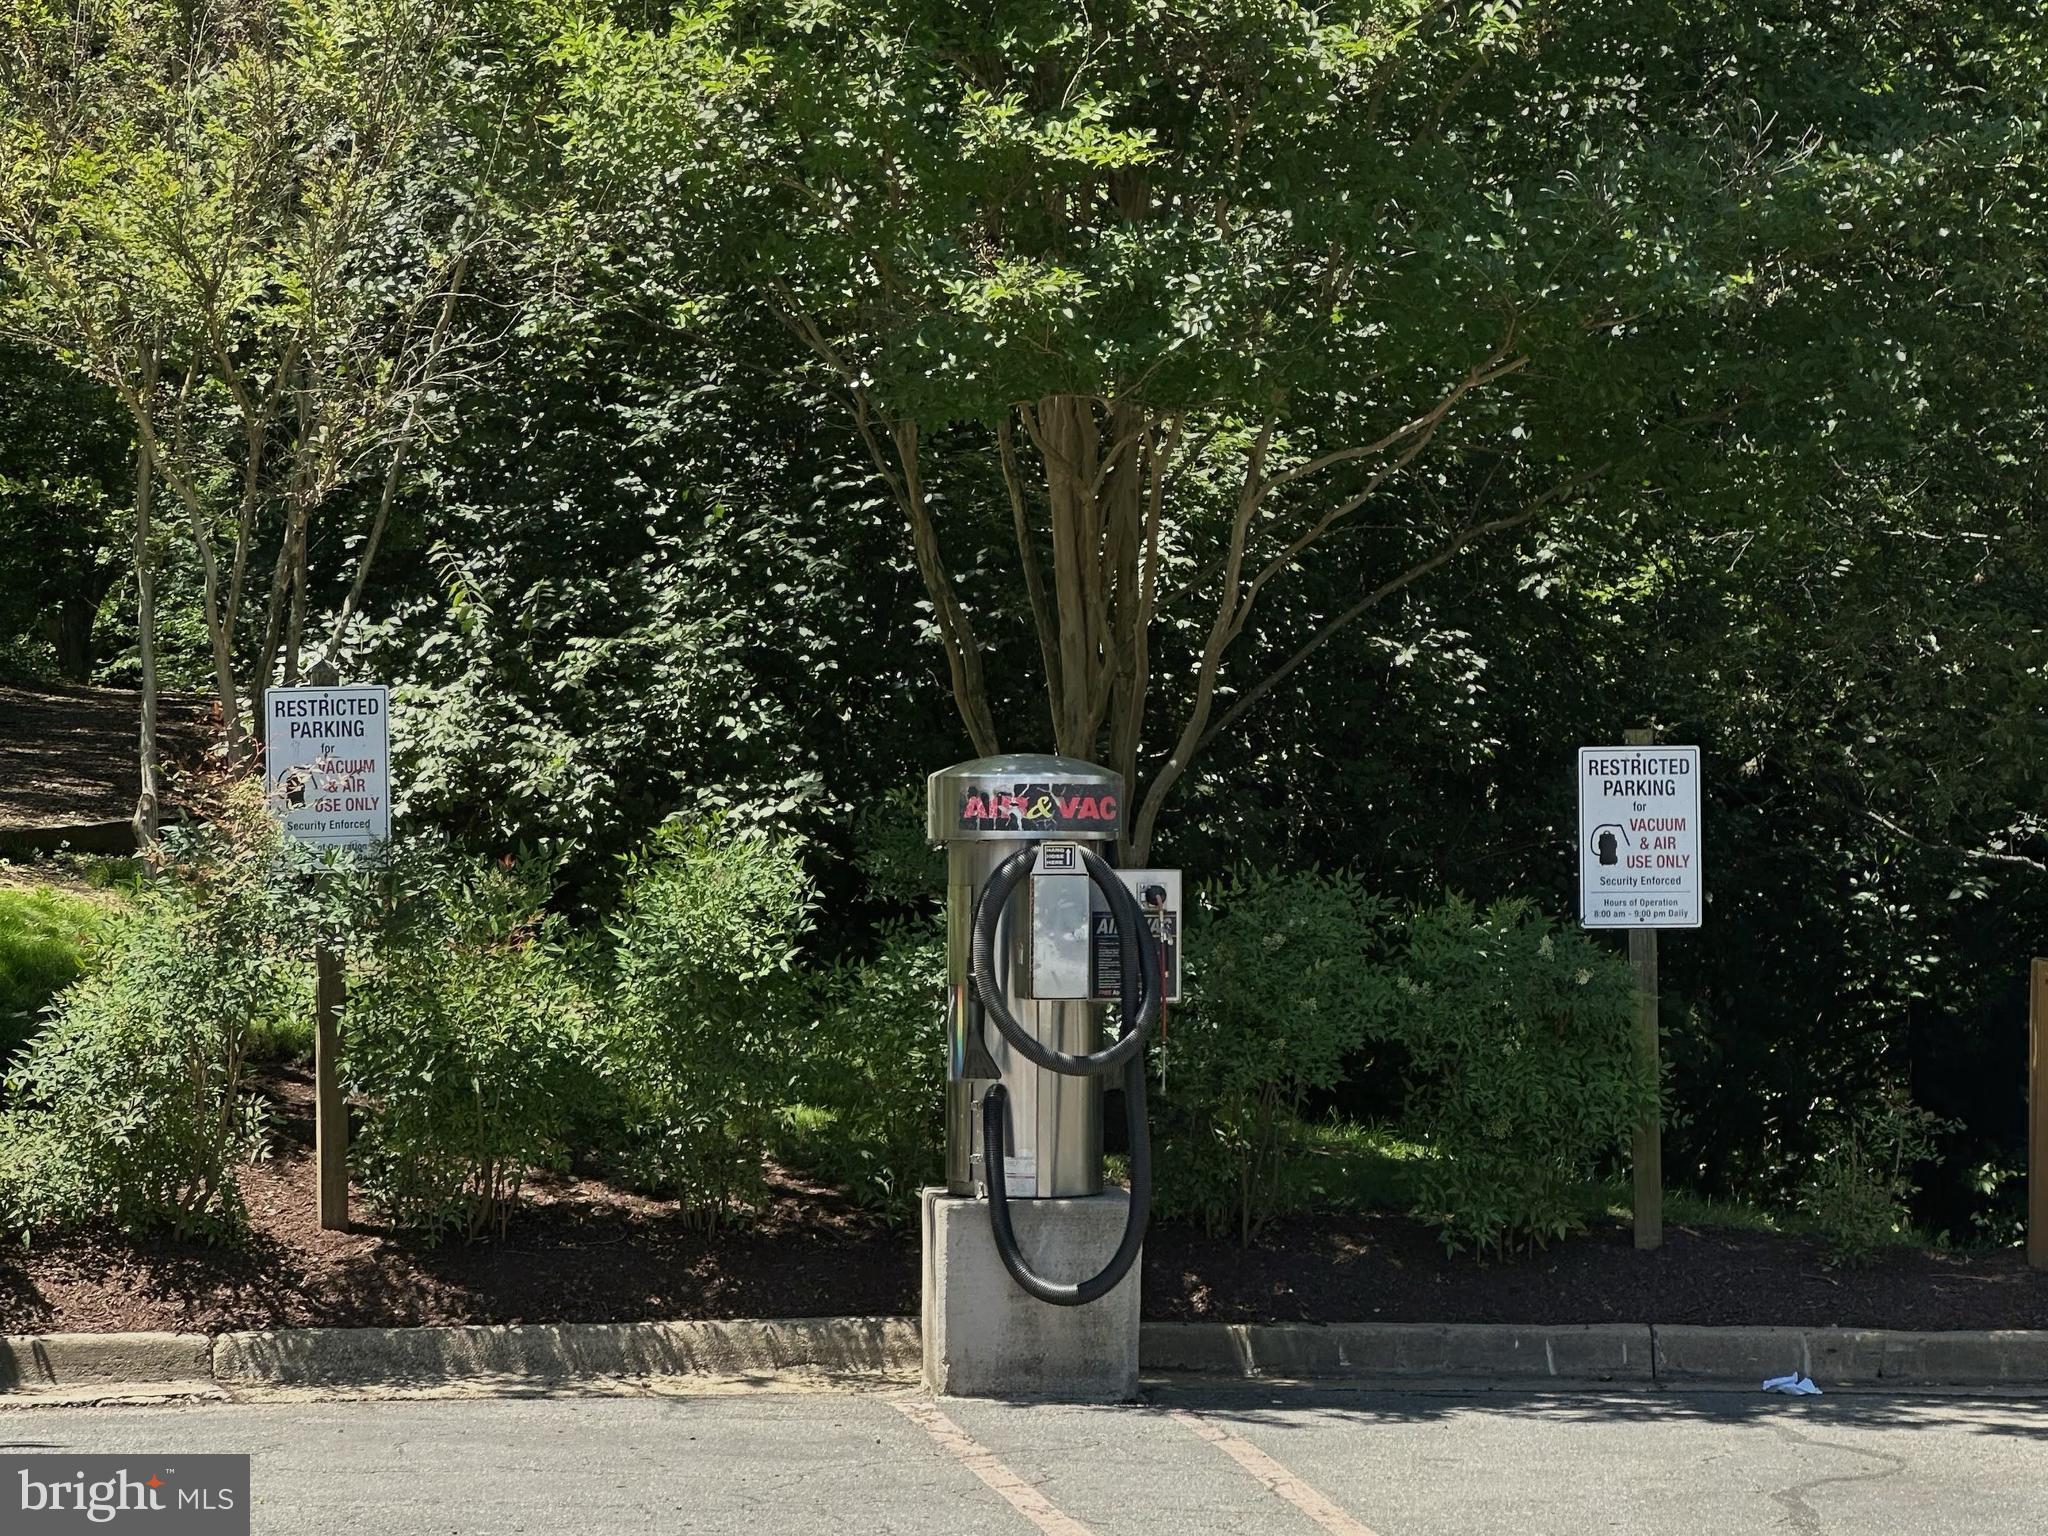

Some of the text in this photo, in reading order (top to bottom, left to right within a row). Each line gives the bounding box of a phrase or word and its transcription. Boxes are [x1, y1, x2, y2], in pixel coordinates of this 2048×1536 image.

[275, 698, 379, 718] RESTRICTED
[290, 720, 365, 739] PARKING
[321, 743, 335, 754] for
[1588, 758, 1690, 776] RESTRICTED
[342, 778, 366, 793] AIR
[1603, 780, 1676, 797] PARKING
[315, 797, 380, 813] USE ONLY
[963, 795, 1117, 821] AIR & VAC
[1633, 801, 1647, 812] for
[287, 819, 371, 832] Security Enforced
[1629, 818, 1686, 832] VACUUM
[1639, 836, 1677, 850] & AIR
[1626, 854, 1690, 869] USE ONLY
[1600, 875, 1682, 888] Security Enforced
[1603, 898, 1679, 908] Hours of Operation
[1593, 910, 1611, 918] 8:00
[1653, 910, 1666, 919] pm
[1668, 909, 1689, 918] Daily
